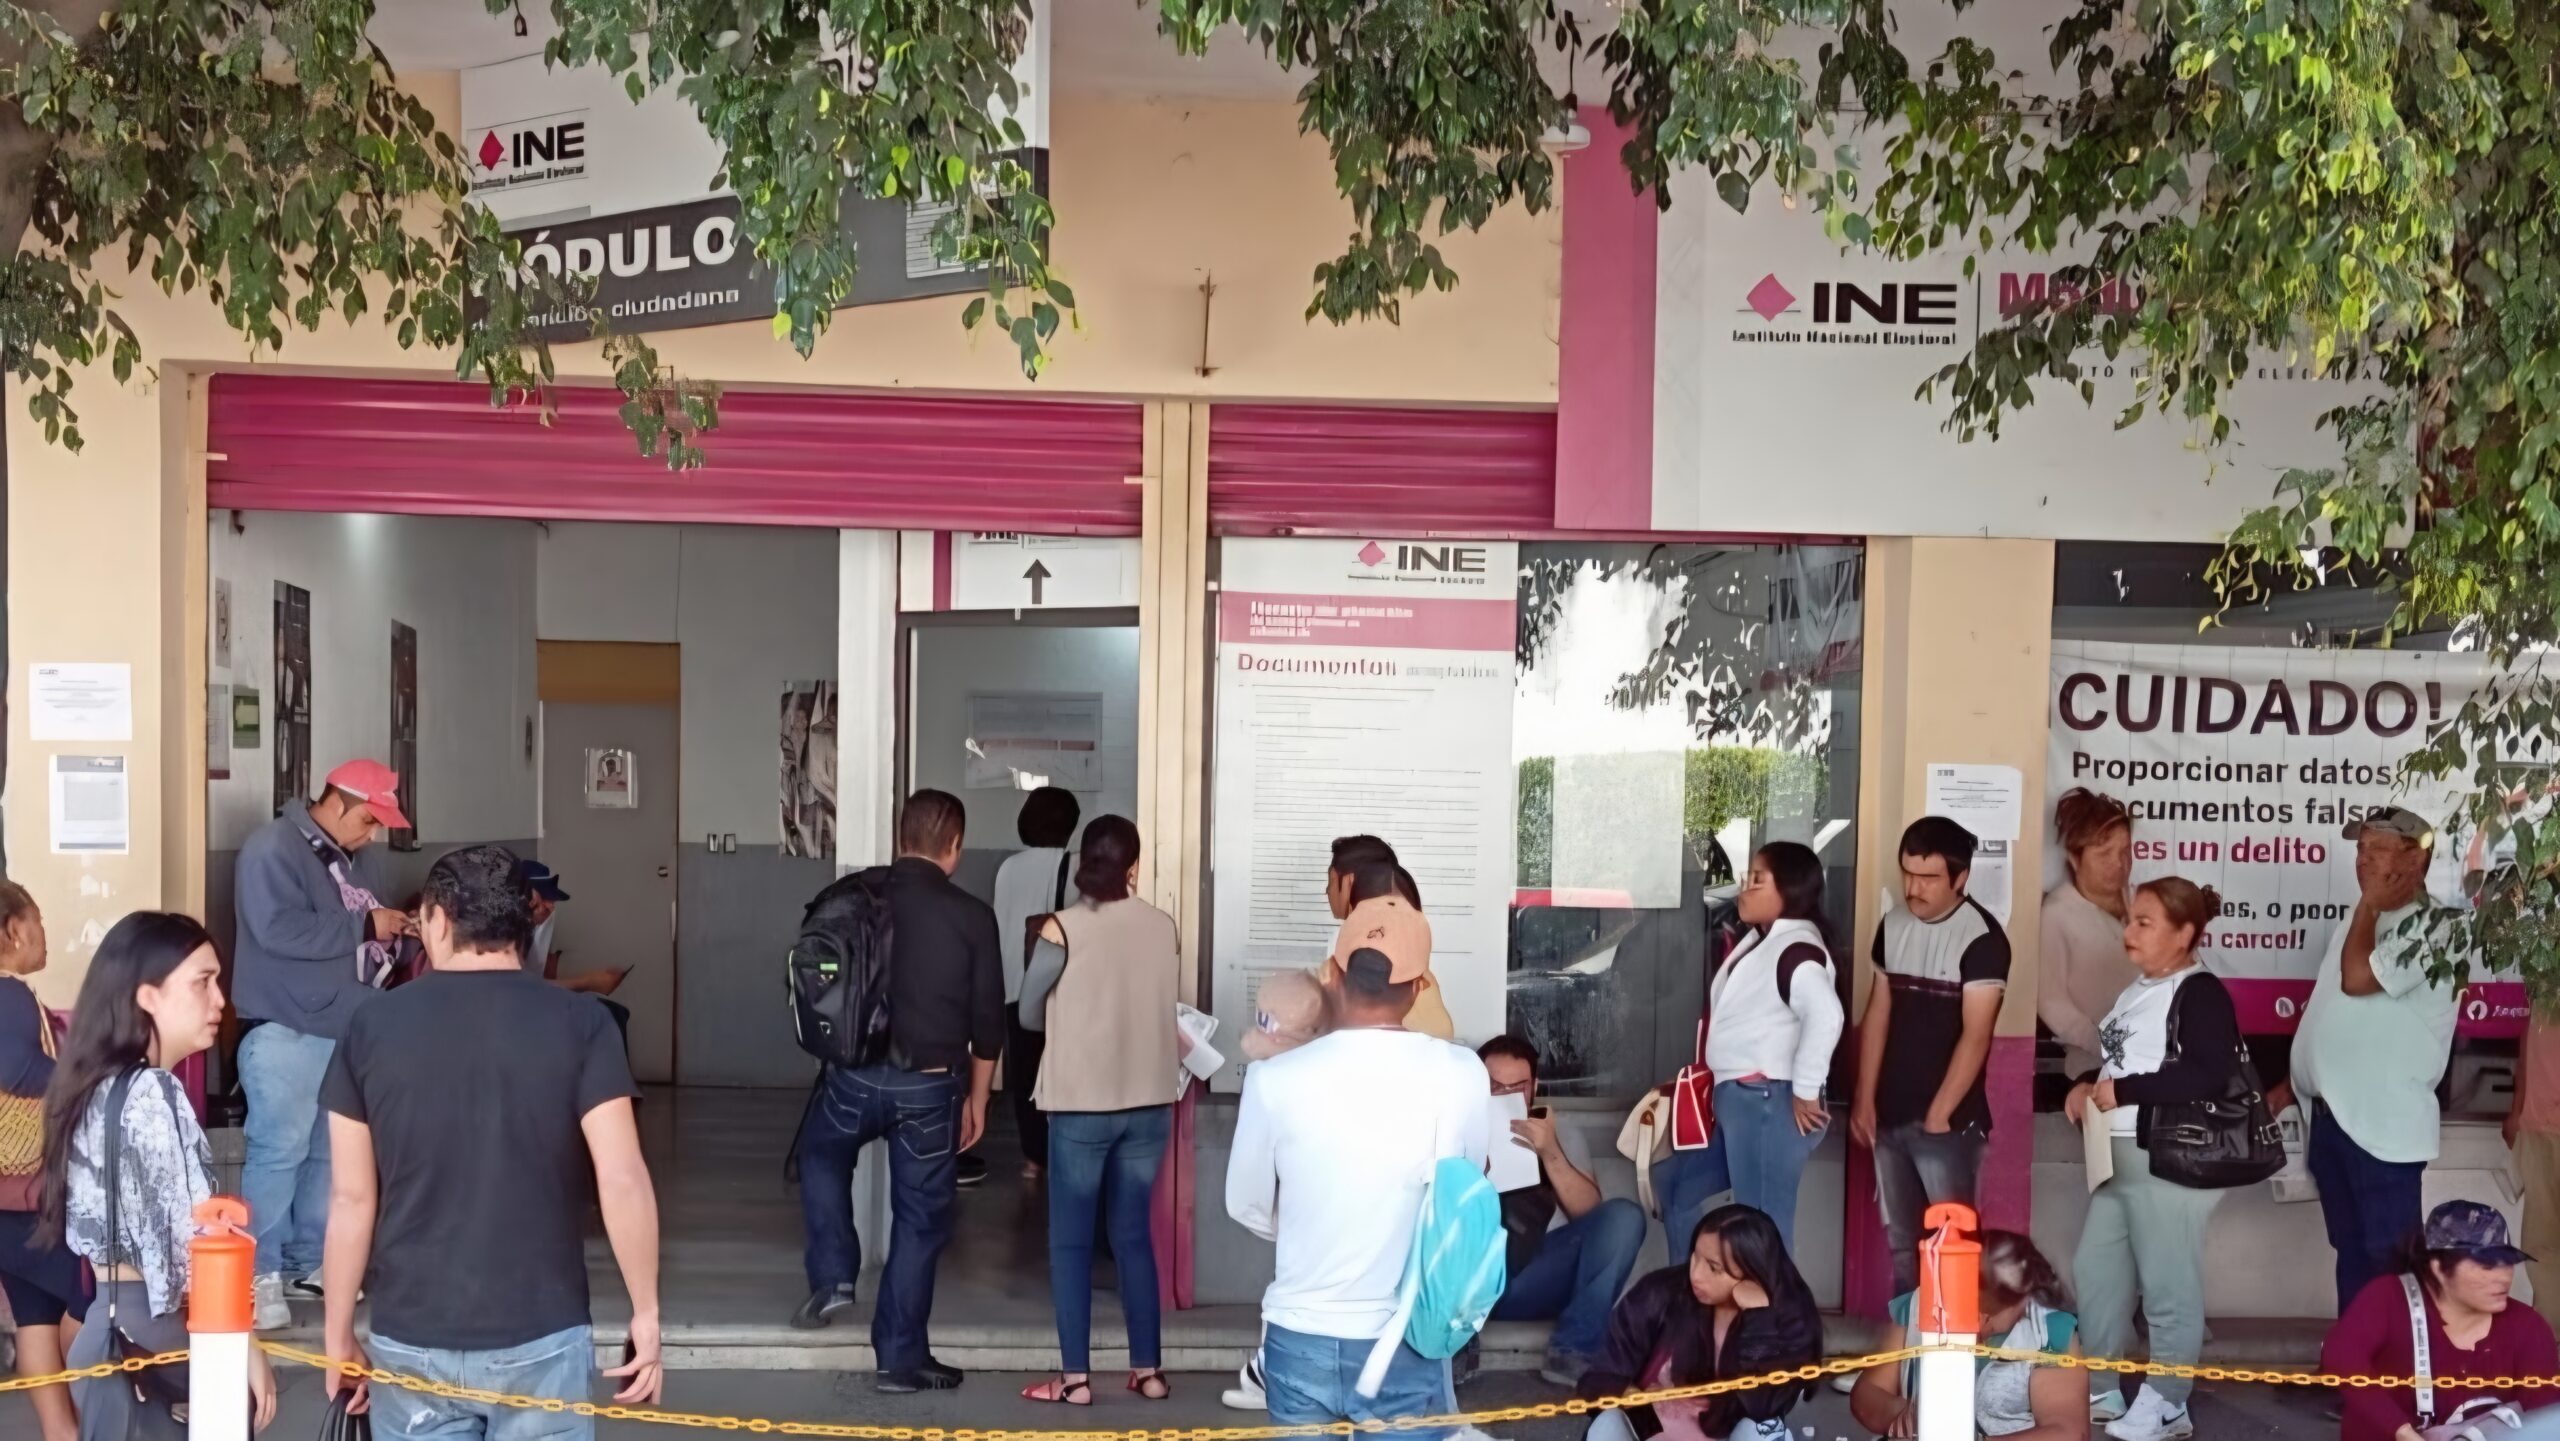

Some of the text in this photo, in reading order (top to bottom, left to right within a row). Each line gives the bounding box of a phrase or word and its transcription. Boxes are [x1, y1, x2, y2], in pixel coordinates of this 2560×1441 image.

[512, 121, 585, 169] INE
[1813, 282, 1957, 325] INE
[1398, 545, 1486, 573] INE
[2059, 671, 2445, 739] CUIDADO!
[2073, 751, 2391, 786] Proporcionar datos
[2133, 836, 2326, 864] es un delito
[2267, 902, 2281, 919] o
